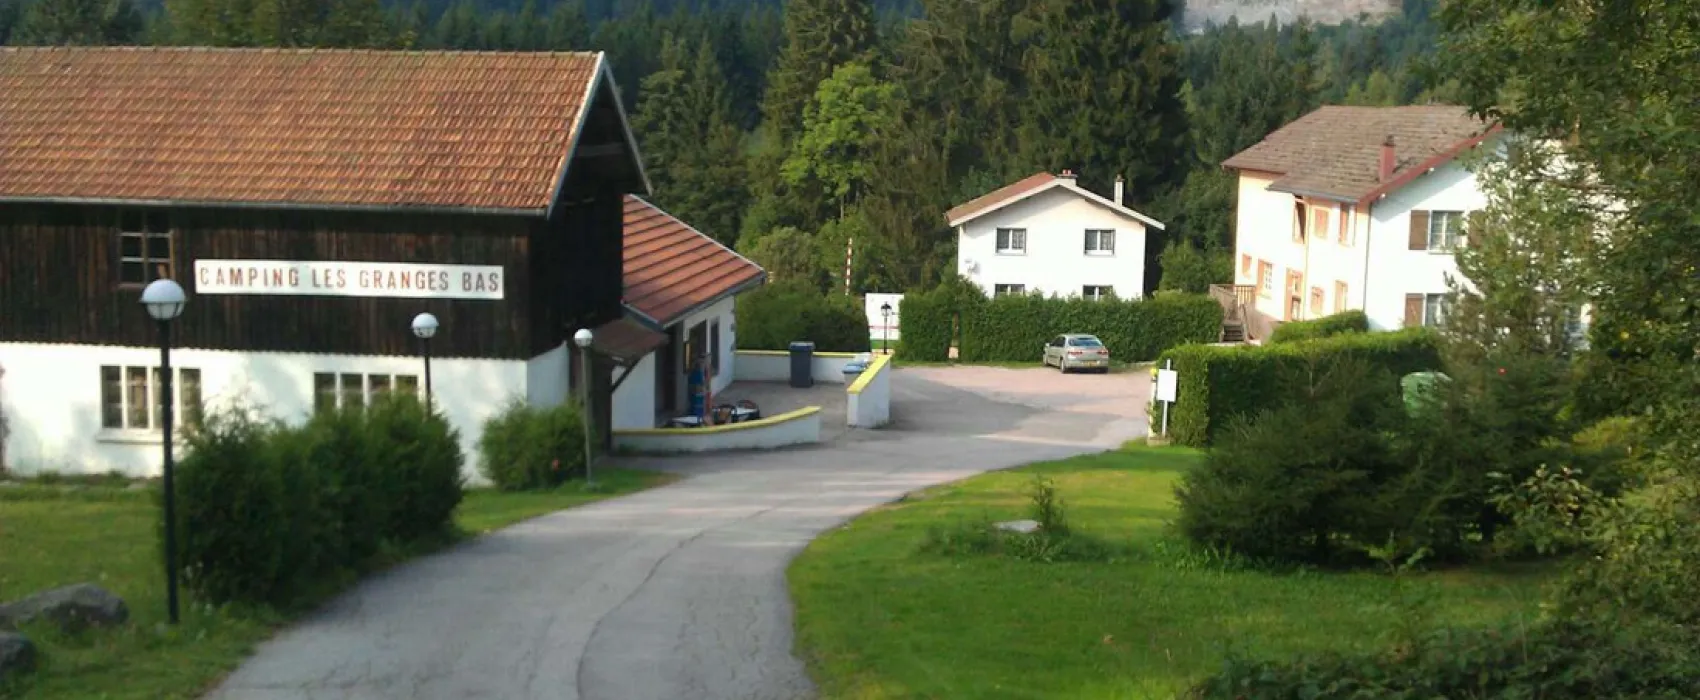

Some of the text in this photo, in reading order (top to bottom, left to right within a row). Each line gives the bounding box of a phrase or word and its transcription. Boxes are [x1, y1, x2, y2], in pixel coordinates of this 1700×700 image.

[200, 267, 500, 292] CAMPING LES GRANGES BAS
